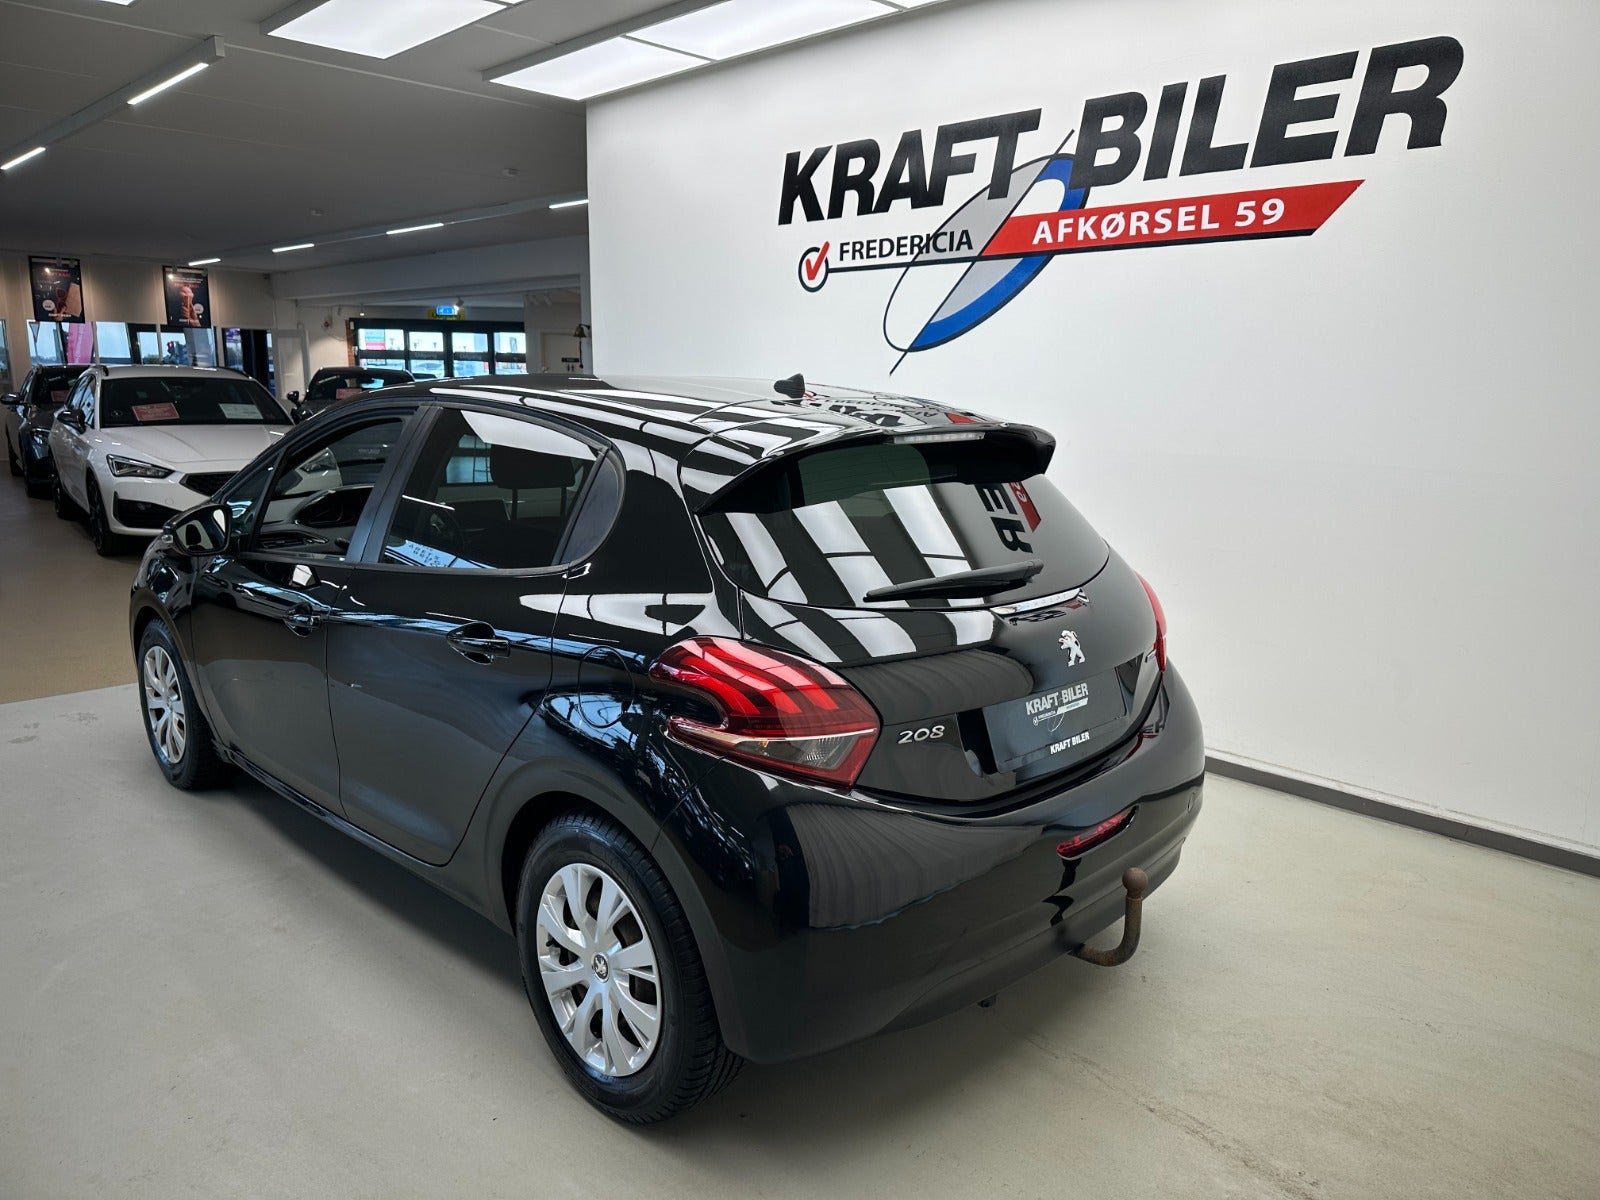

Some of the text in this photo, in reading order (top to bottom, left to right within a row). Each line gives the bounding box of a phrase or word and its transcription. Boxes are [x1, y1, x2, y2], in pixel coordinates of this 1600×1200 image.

[778, 35, 1465, 226] KRAFT BILER
[1031, 198, 1286, 245] AFKØRSEL 59
[838, 230, 974, 262] FREDERICIA
[1025, 682, 1089, 716] KRAFT BILER
[897, 726, 945, 745] 208
[1049, 731, 1090, 755] KRAFT BILER
